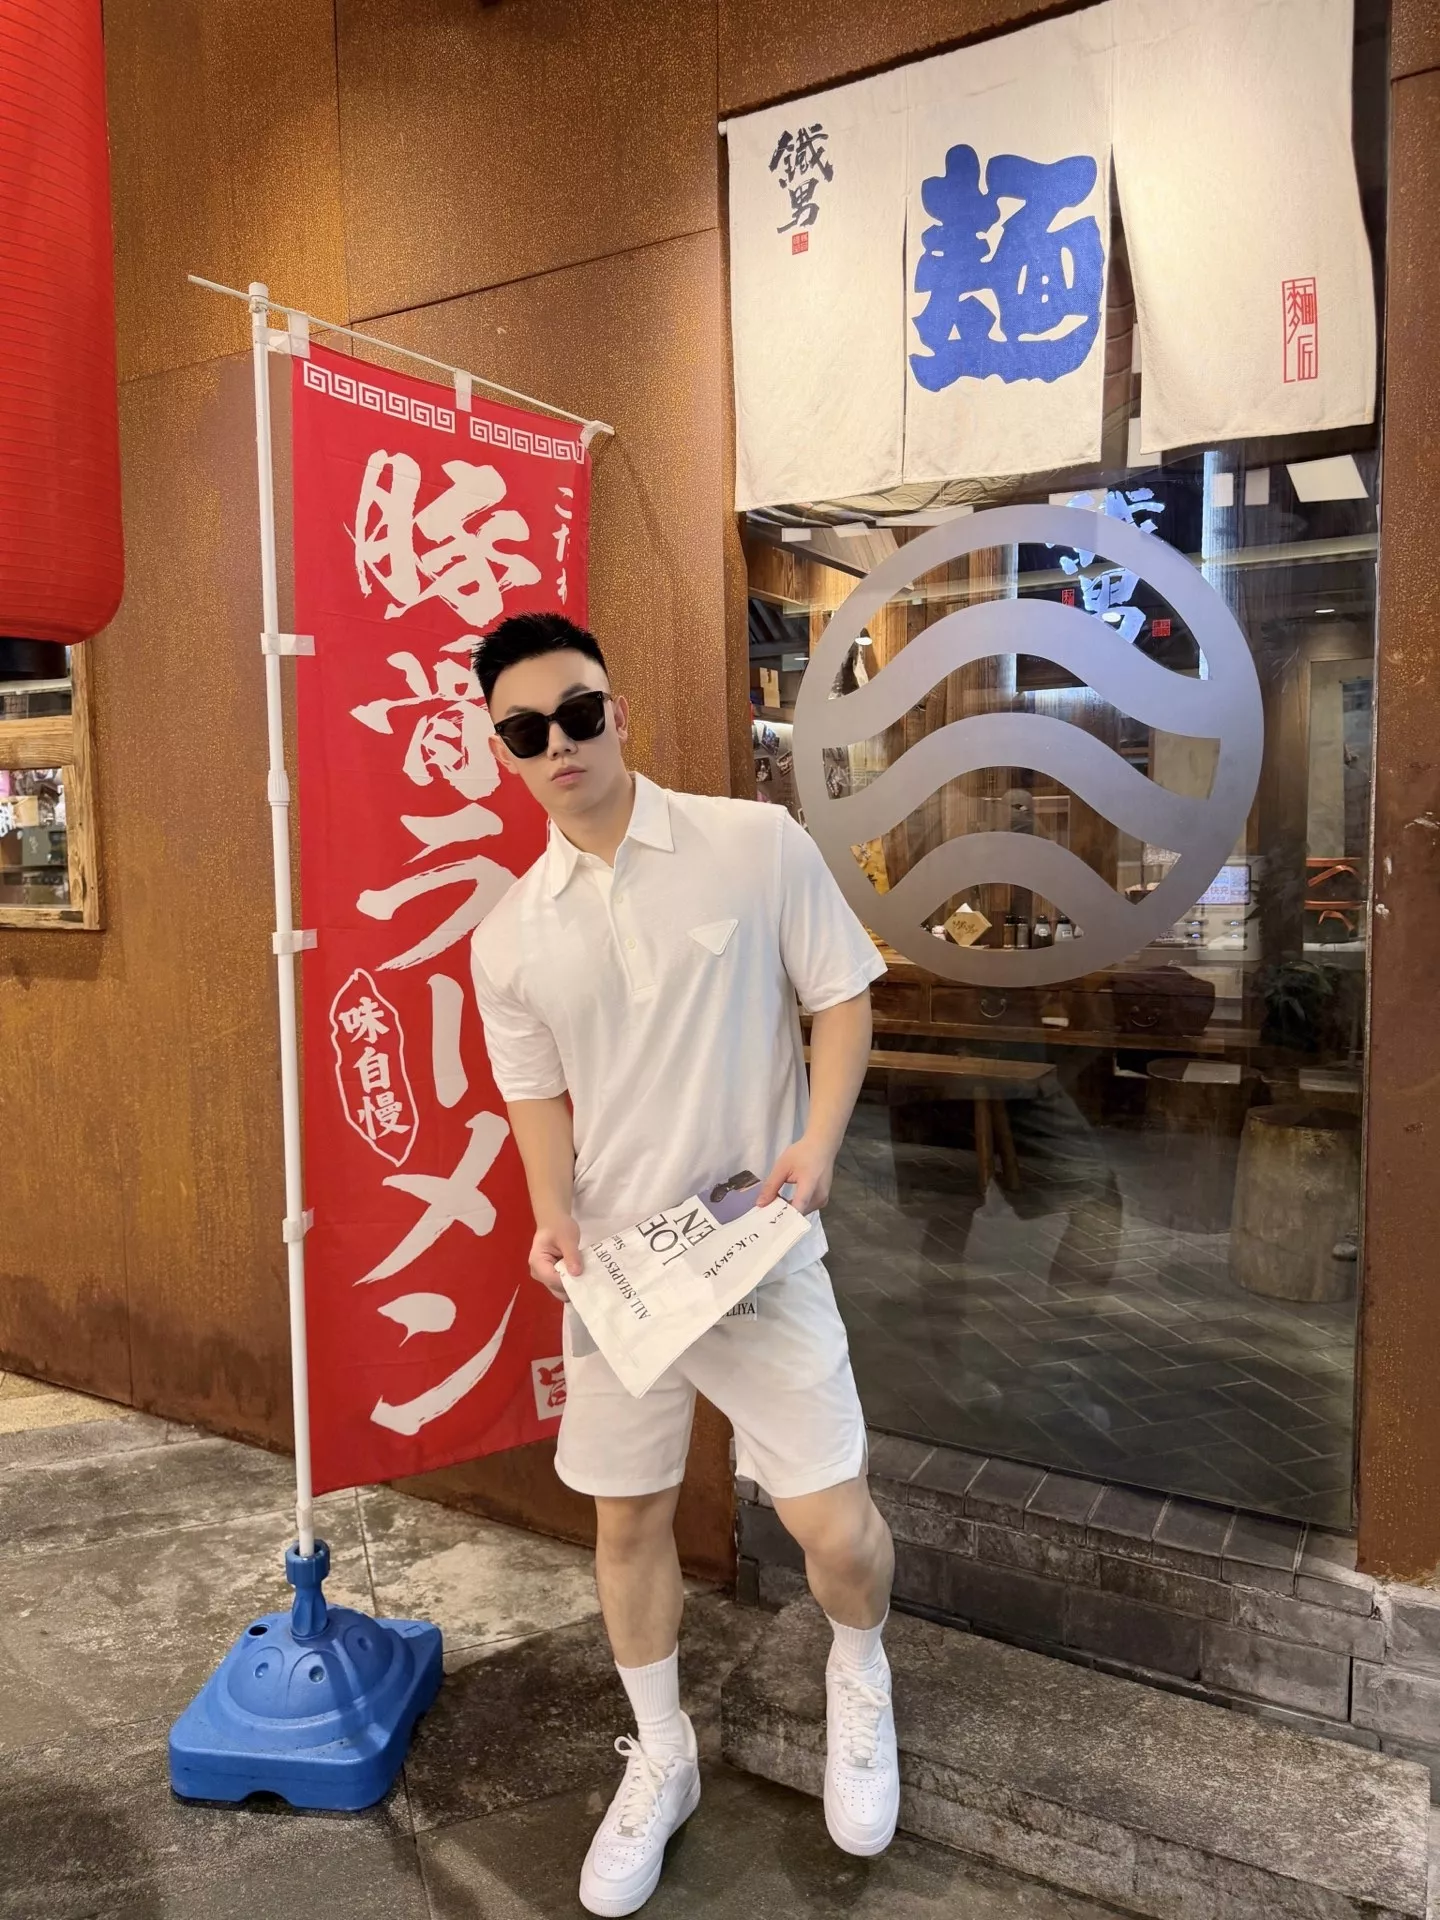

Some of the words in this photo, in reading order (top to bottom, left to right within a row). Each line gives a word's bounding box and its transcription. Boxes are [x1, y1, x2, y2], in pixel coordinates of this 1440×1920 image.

[339, 996, 411, 1140] 味自慢
[596, 1249, 612, 1263] OF
[635, 1213, 688, 1266] LOE
[605, 1261, 637, 1300] SHAPES
[630, 1298, 652, 1320] ALL
